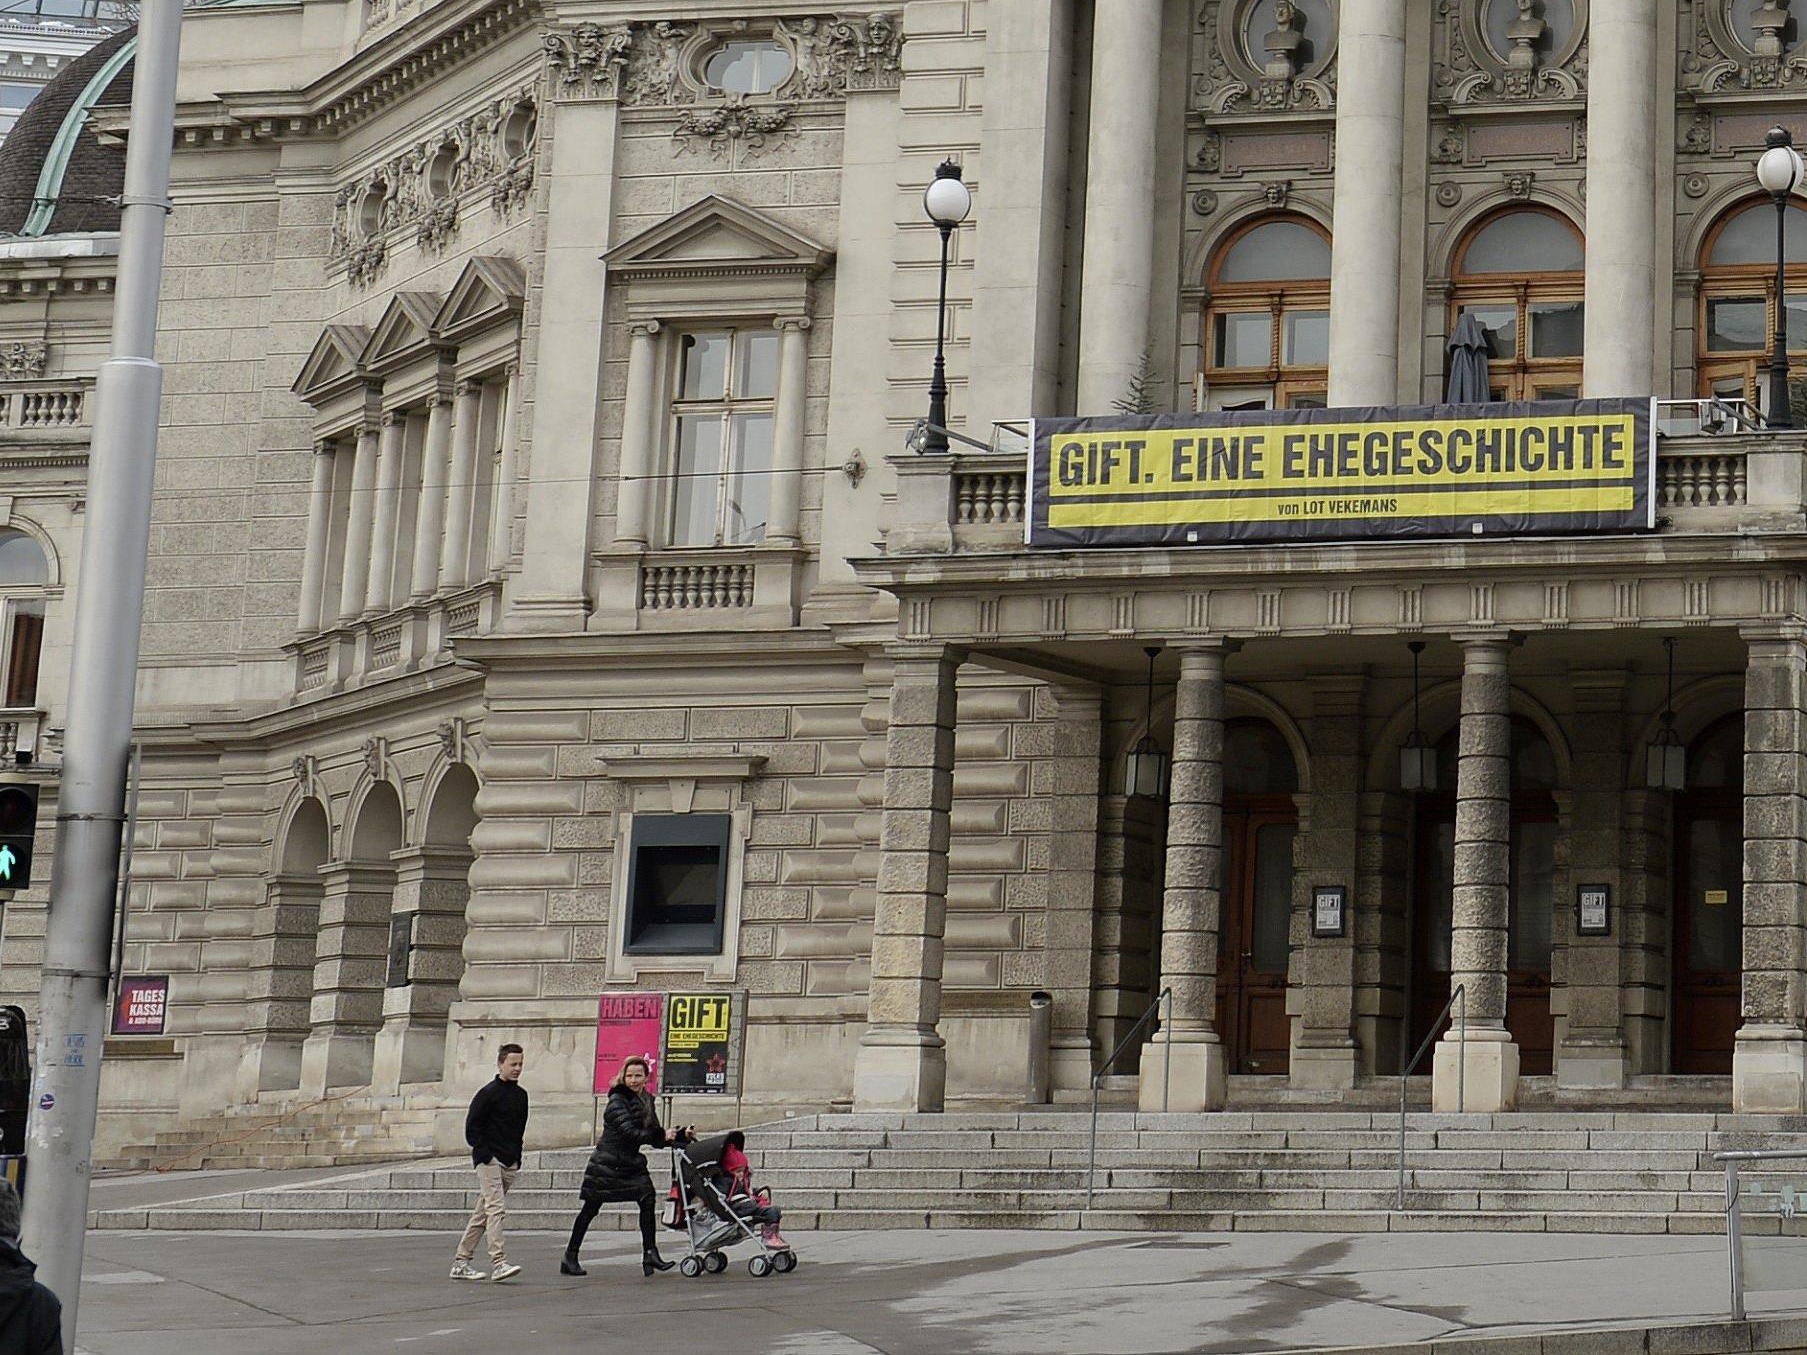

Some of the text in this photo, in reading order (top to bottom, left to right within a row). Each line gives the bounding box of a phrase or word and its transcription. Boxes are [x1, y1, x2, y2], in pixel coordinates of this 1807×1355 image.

[1058, 423, 1625, 486] GIFT. EINE EHEGESCHICHTE
[1278, 498, 1398, 516] von LOT VEKEMANS
[132, 990, 165, 1002] TAGES
[129, 1004, 163, 1016] KASSA
[602, 998, 657, 1018] HABEN
[672, 998, 727, 1028] GIFT
